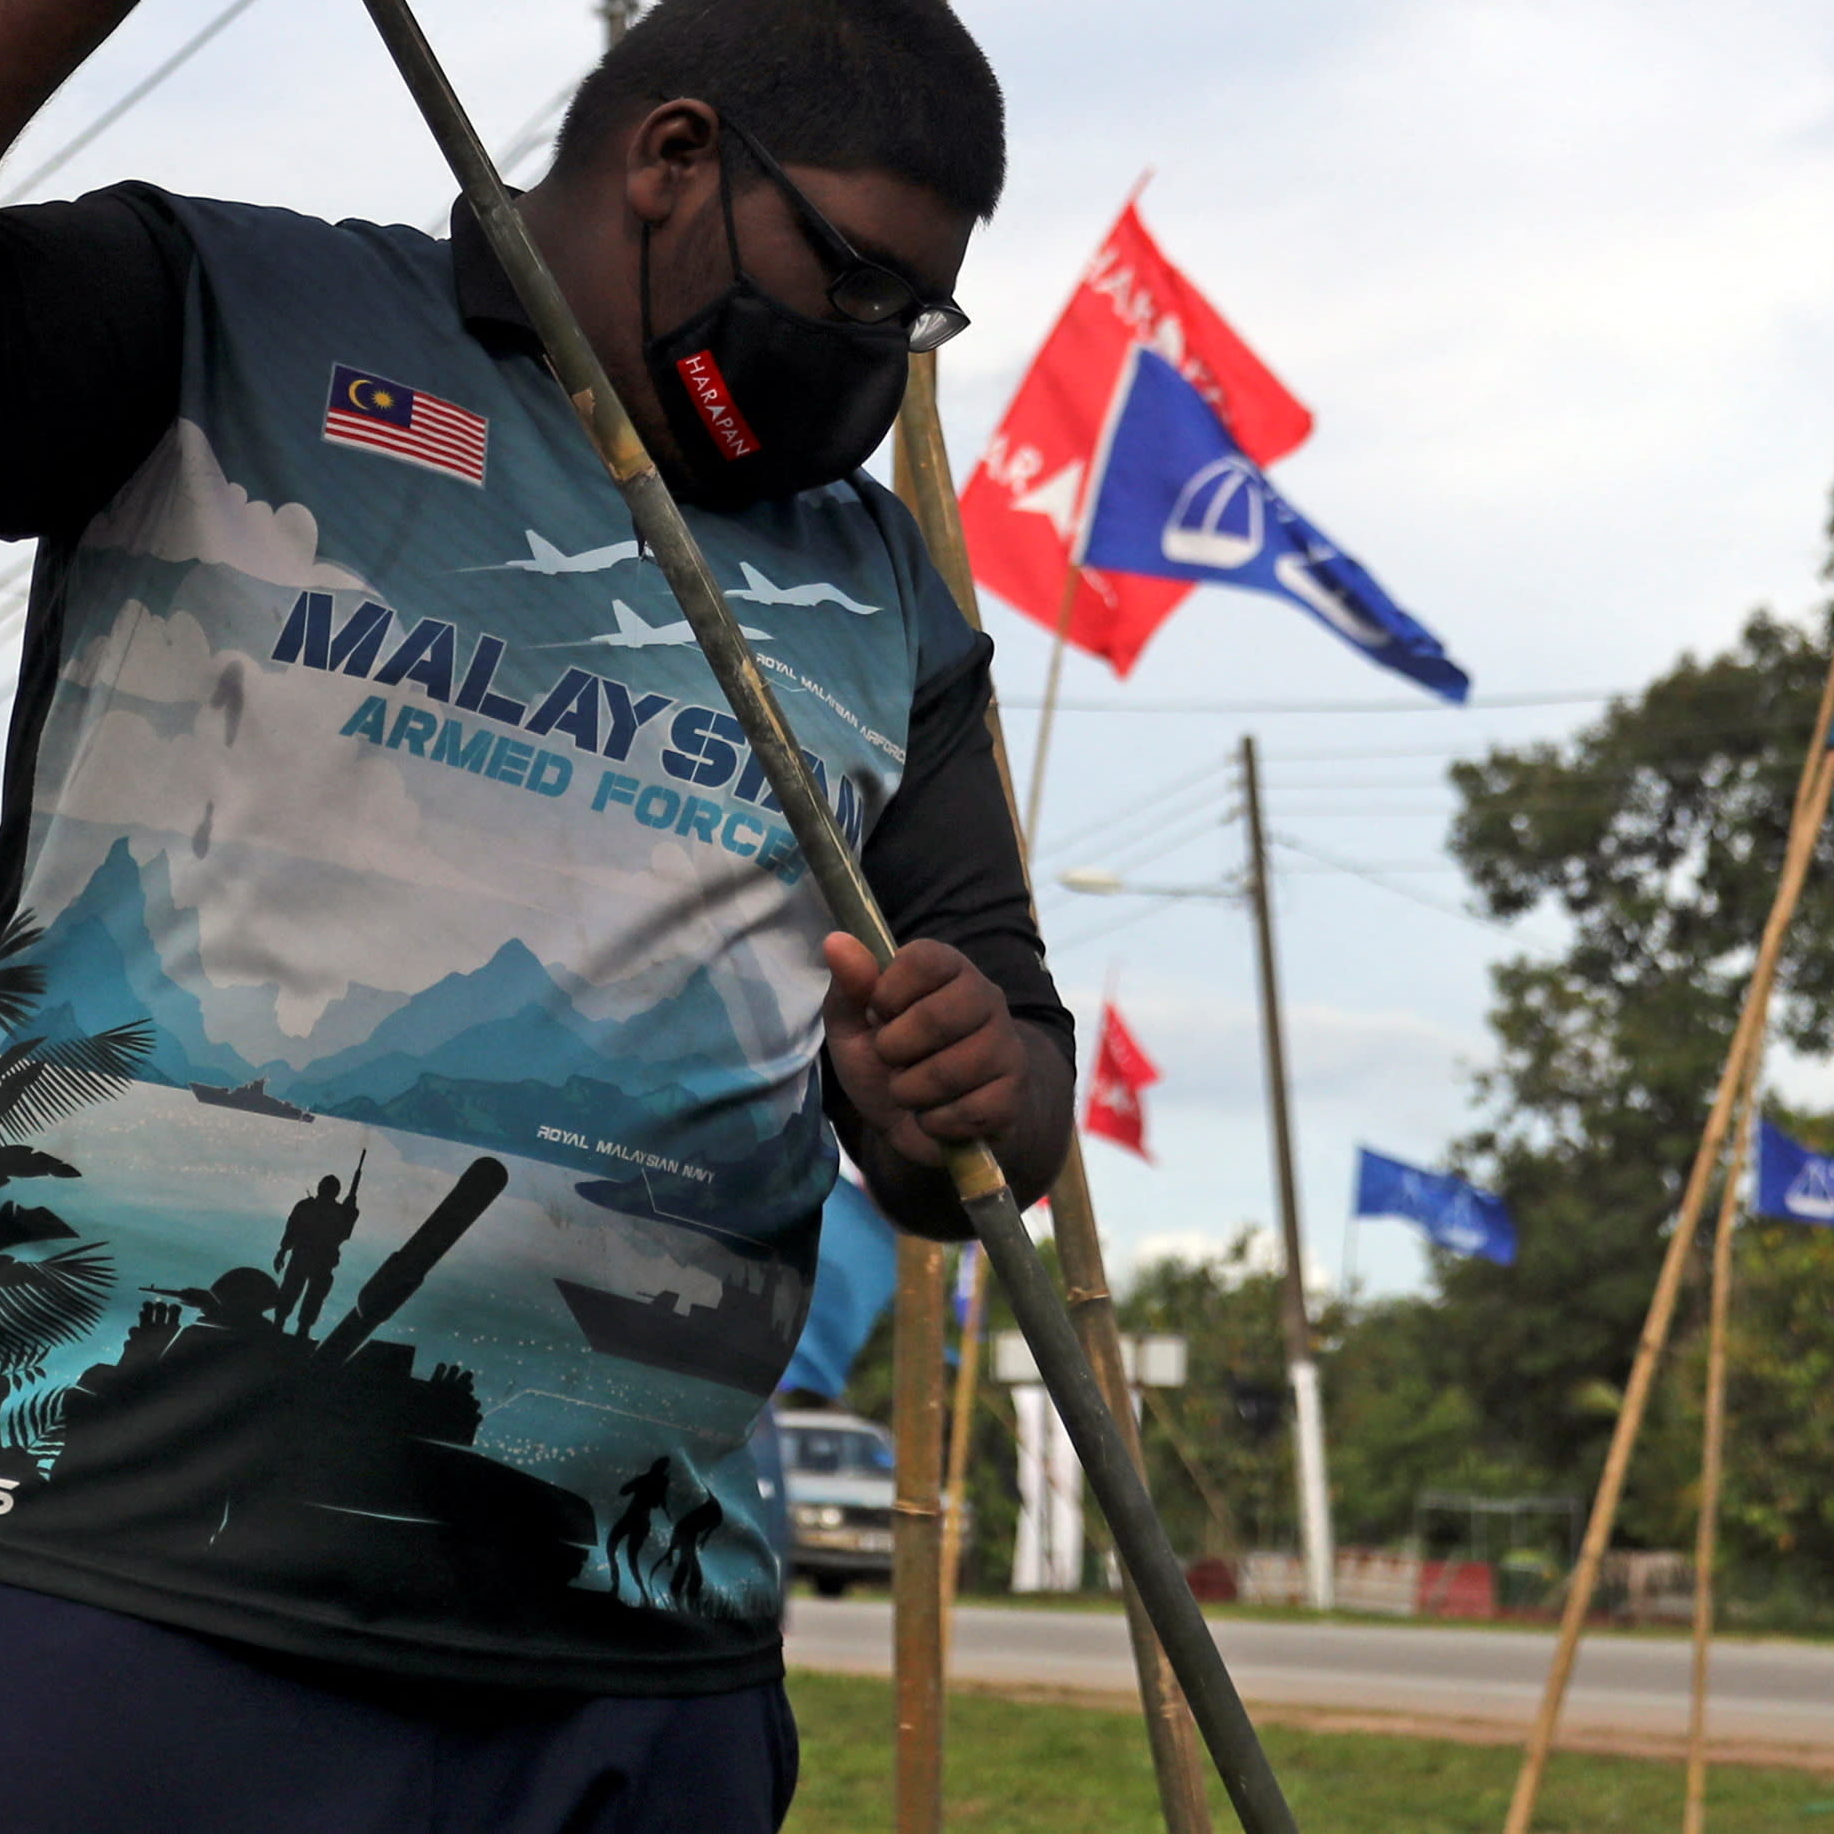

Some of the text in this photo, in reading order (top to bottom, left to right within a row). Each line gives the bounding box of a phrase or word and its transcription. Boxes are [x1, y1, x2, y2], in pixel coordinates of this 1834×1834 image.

[685, 355, 751, 458] HARAPAN
[756, 652, 797, 681] ROYAL
[339, 696, 573, 799] ARMED
[536, 1124, 716, 1185] ROYAL MALAYSIAN NAVY
